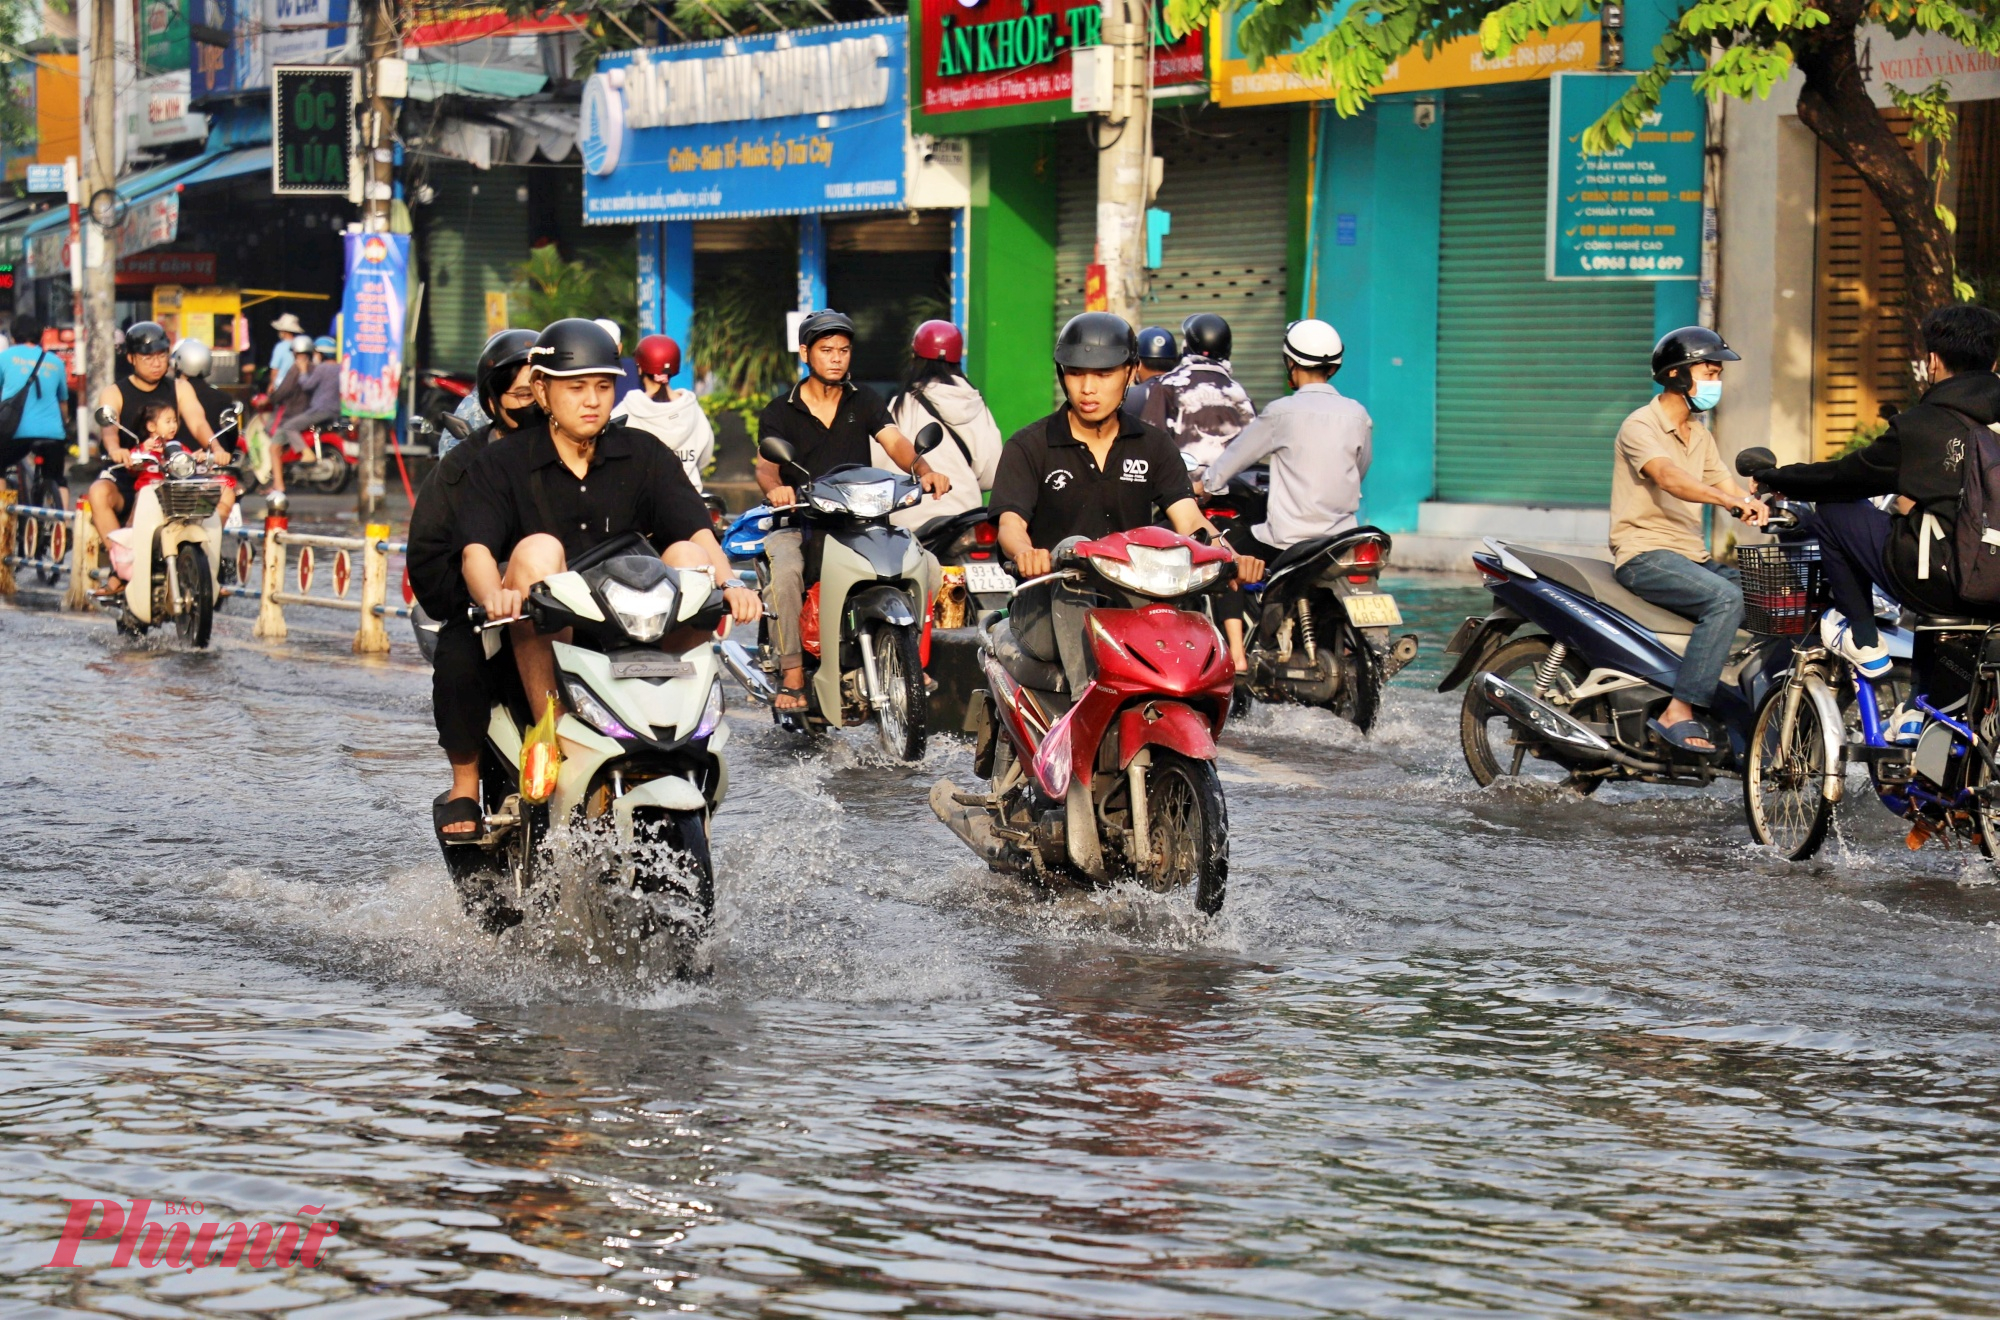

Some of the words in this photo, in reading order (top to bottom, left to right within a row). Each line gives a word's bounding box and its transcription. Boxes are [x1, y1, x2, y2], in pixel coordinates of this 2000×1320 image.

[1880, 47, 1933, 80] NGUYỄN
[1935, 50, 1964, 74] VĂN
[294, 78, 336, 130] ỐC
[286, 136, 345, 182] LÚA
[1628, 207, 1655, 216] KHOA
[1583, 241, 1613, 251] CÔNG
[1641, 241, 1664, 251] CAO
[1148, 608, 1178, 616] HONDA
[1539, 588, 1596, 620] FUTURE
[1096, 684, 1118, 695] HONDA
